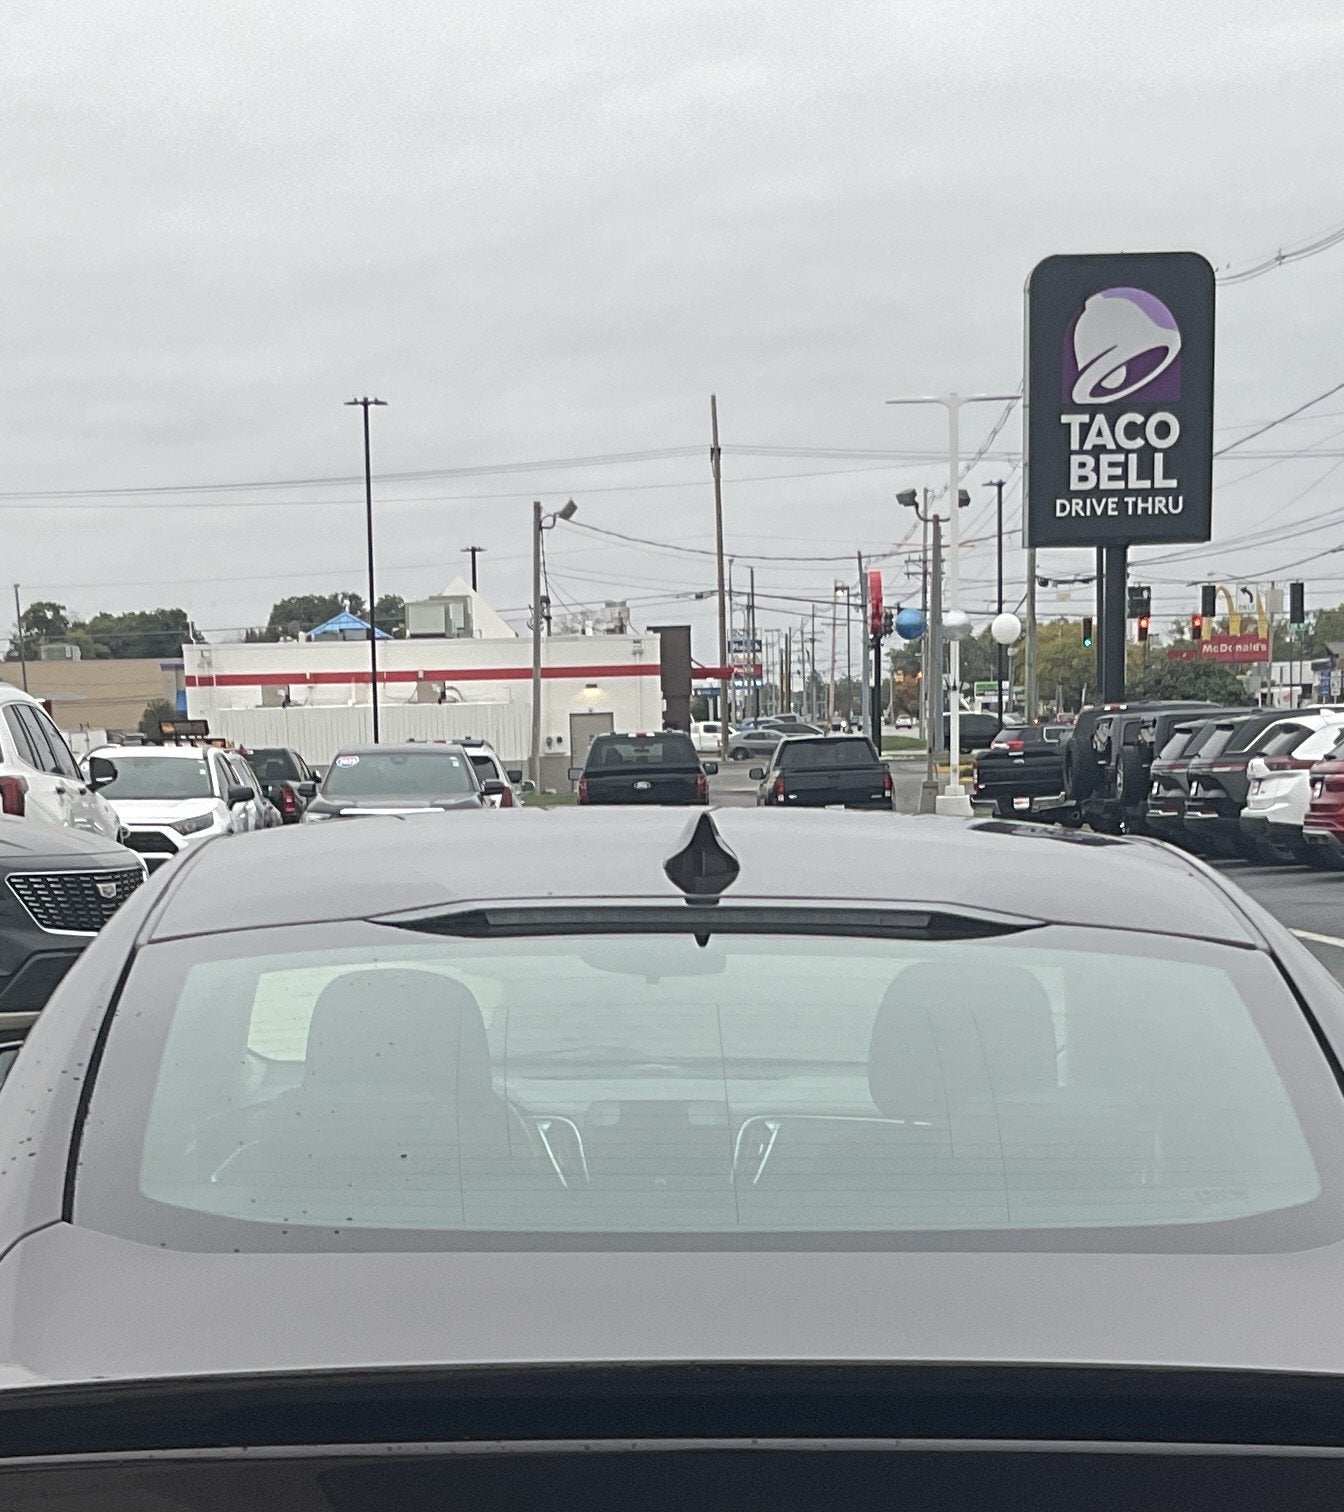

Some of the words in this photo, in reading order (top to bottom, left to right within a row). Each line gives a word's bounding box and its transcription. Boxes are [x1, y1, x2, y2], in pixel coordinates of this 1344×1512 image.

[1060, 412, 1180, 451] TACO
[1069, 453, 1177, 491] BELL
[1055, 497, 1118, 517] DRIVE
[1124, 496, 1183, 516] THRU
